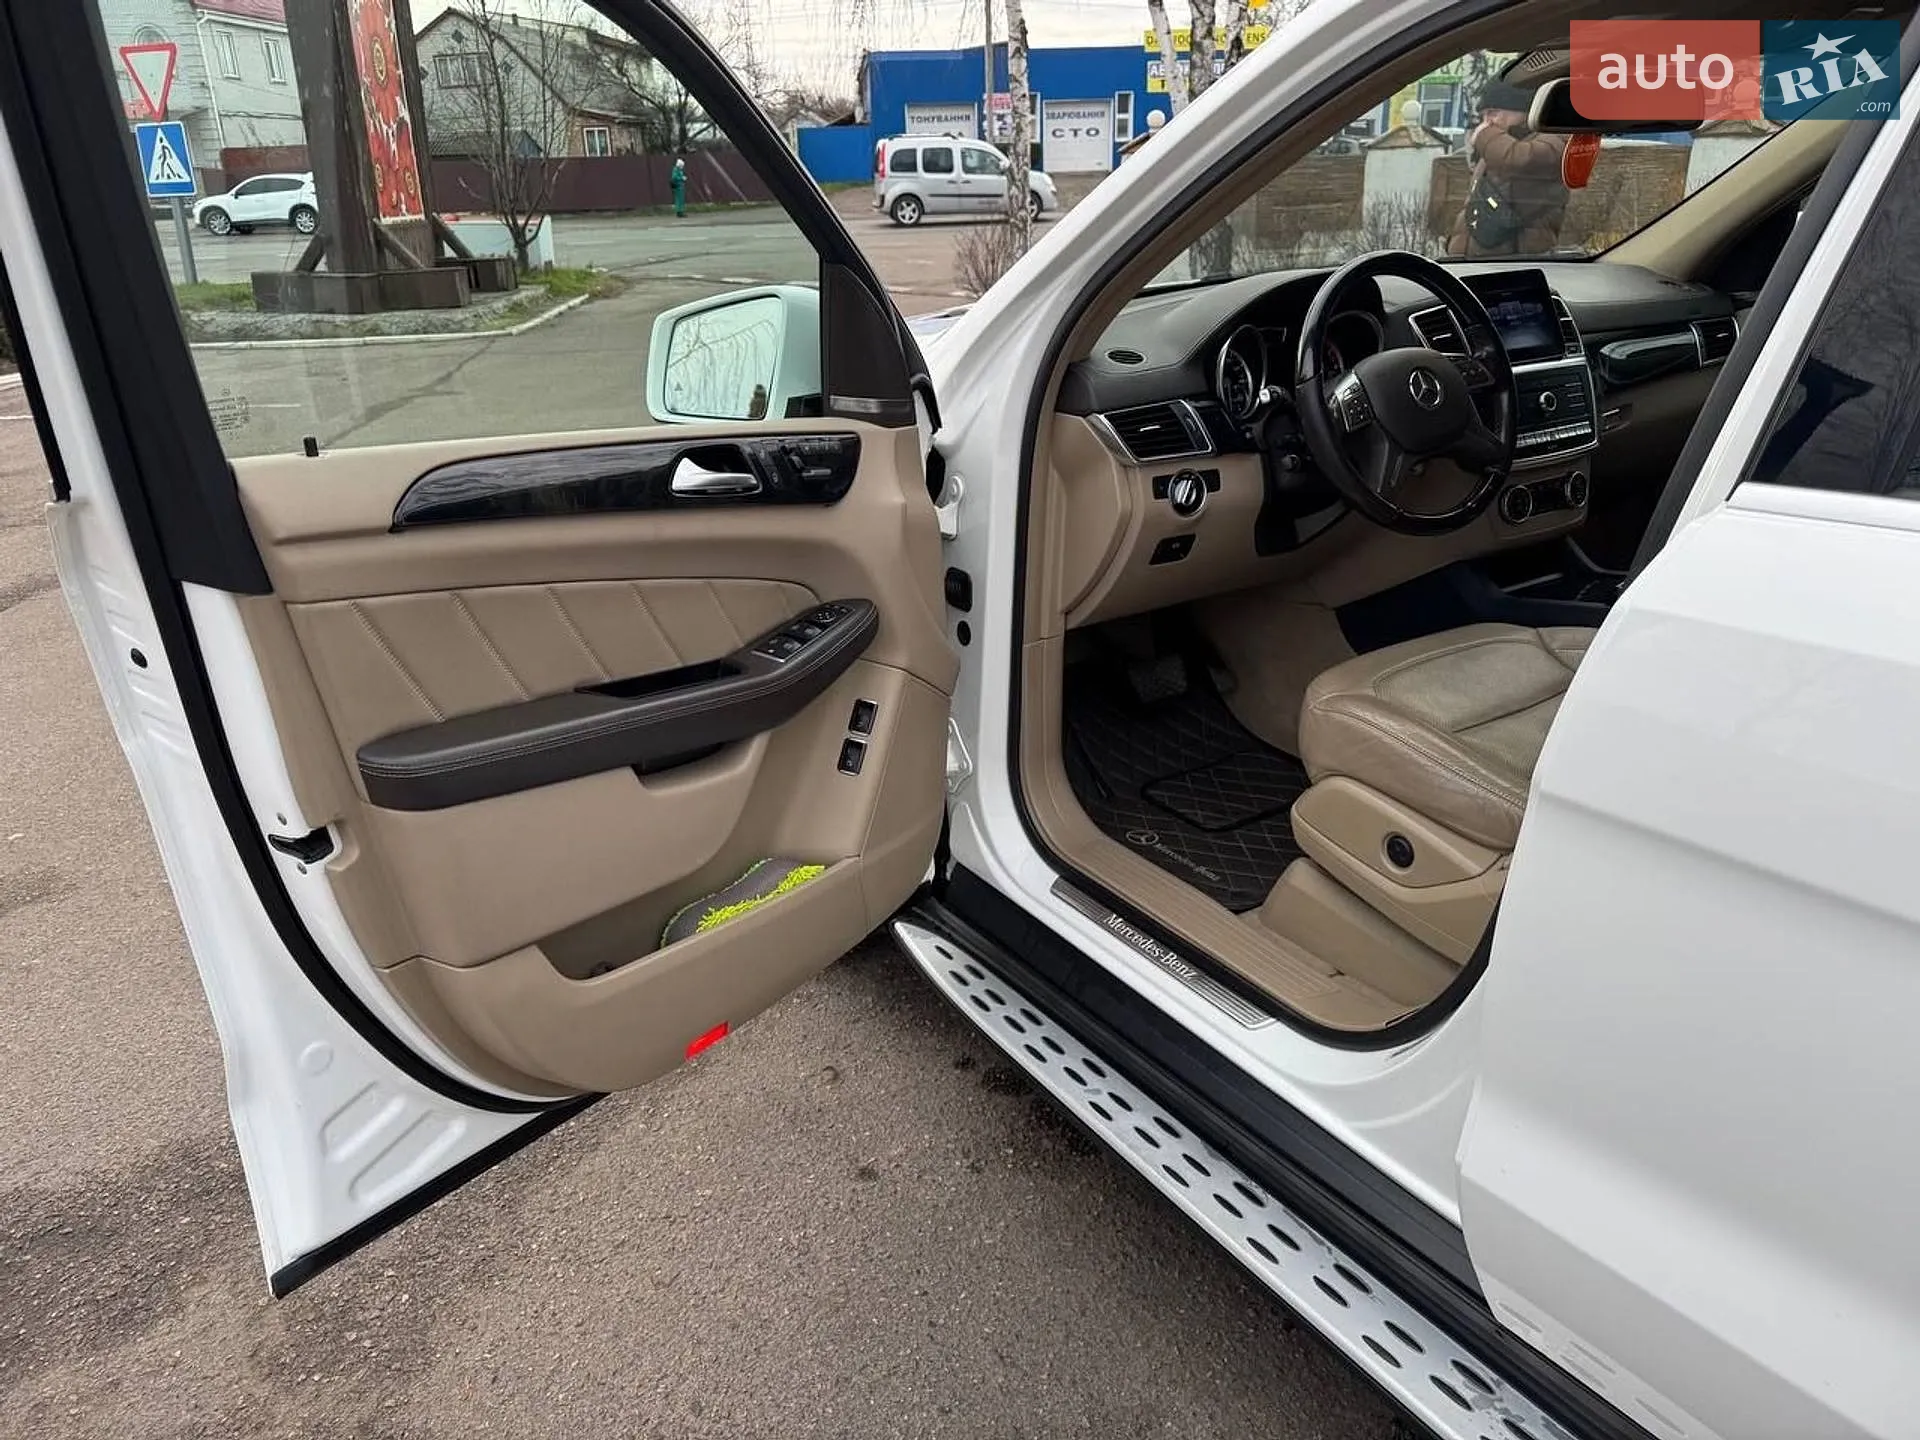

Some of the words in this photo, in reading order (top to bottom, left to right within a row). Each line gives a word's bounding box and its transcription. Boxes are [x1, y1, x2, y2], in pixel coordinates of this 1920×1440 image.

[911, 114, 971, 124] ТОНУВАННЯ
[1052, 127, 1100, 138] СТО
[1103, 913, 1198, 980] Mercedes-Benz
